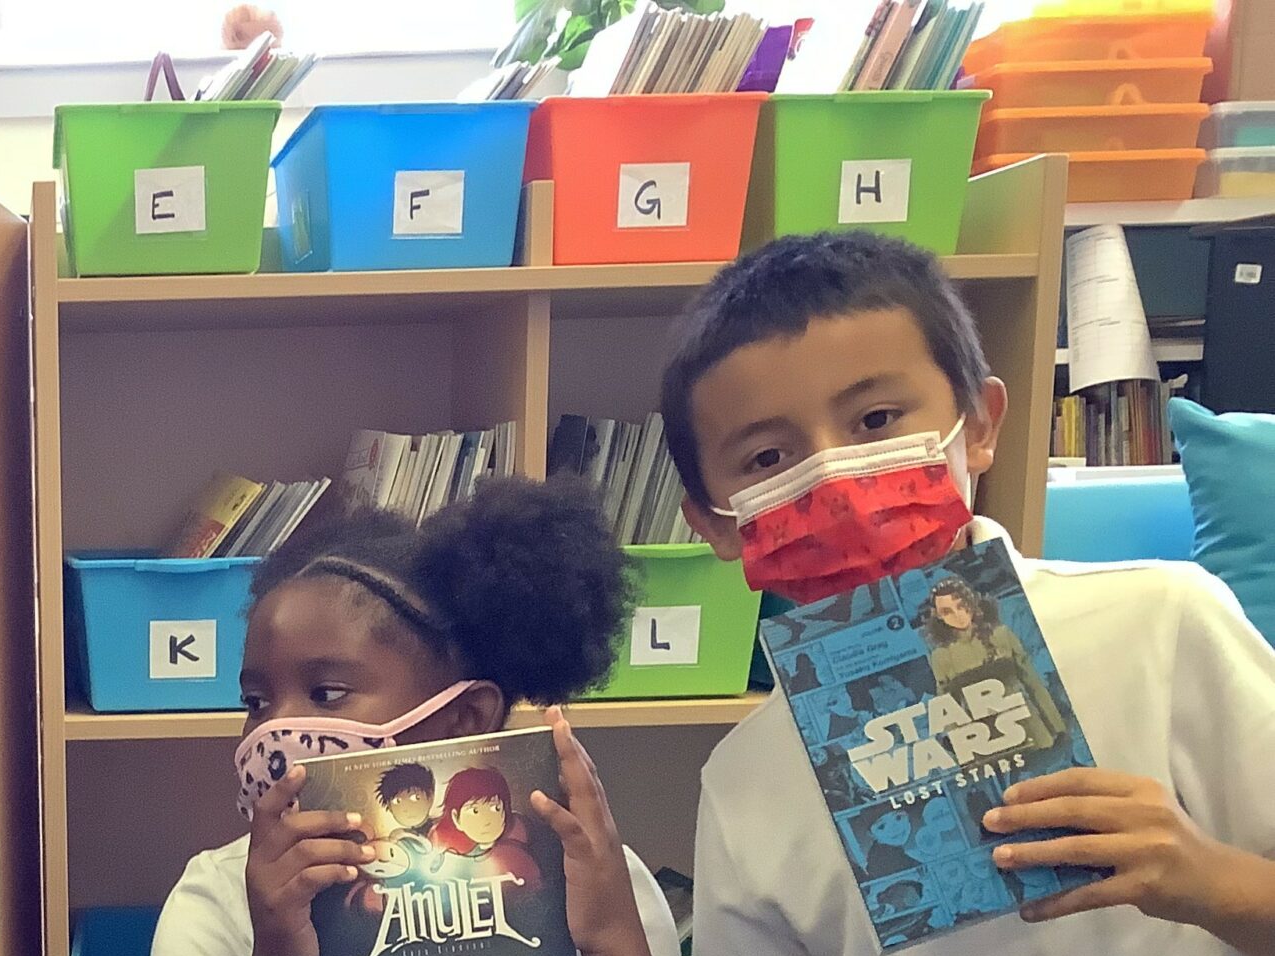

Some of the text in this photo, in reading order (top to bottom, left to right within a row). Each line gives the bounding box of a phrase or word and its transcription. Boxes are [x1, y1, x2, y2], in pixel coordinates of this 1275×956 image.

[409, 188, 430, 220] F
[634, 180, 662, 220] G
[855, 170, 882, 205] H
[151, 190, 176, 221] E
[169, 634, 200, 665] K
[650, 618, 671, 651] L
[847, 678, 1026, 763] STAR
[468, 745, 500, 755] AUTHOR
[851, 705, 1032, 793] WARS
[888, 753, 1025, 810] LOST STARS
